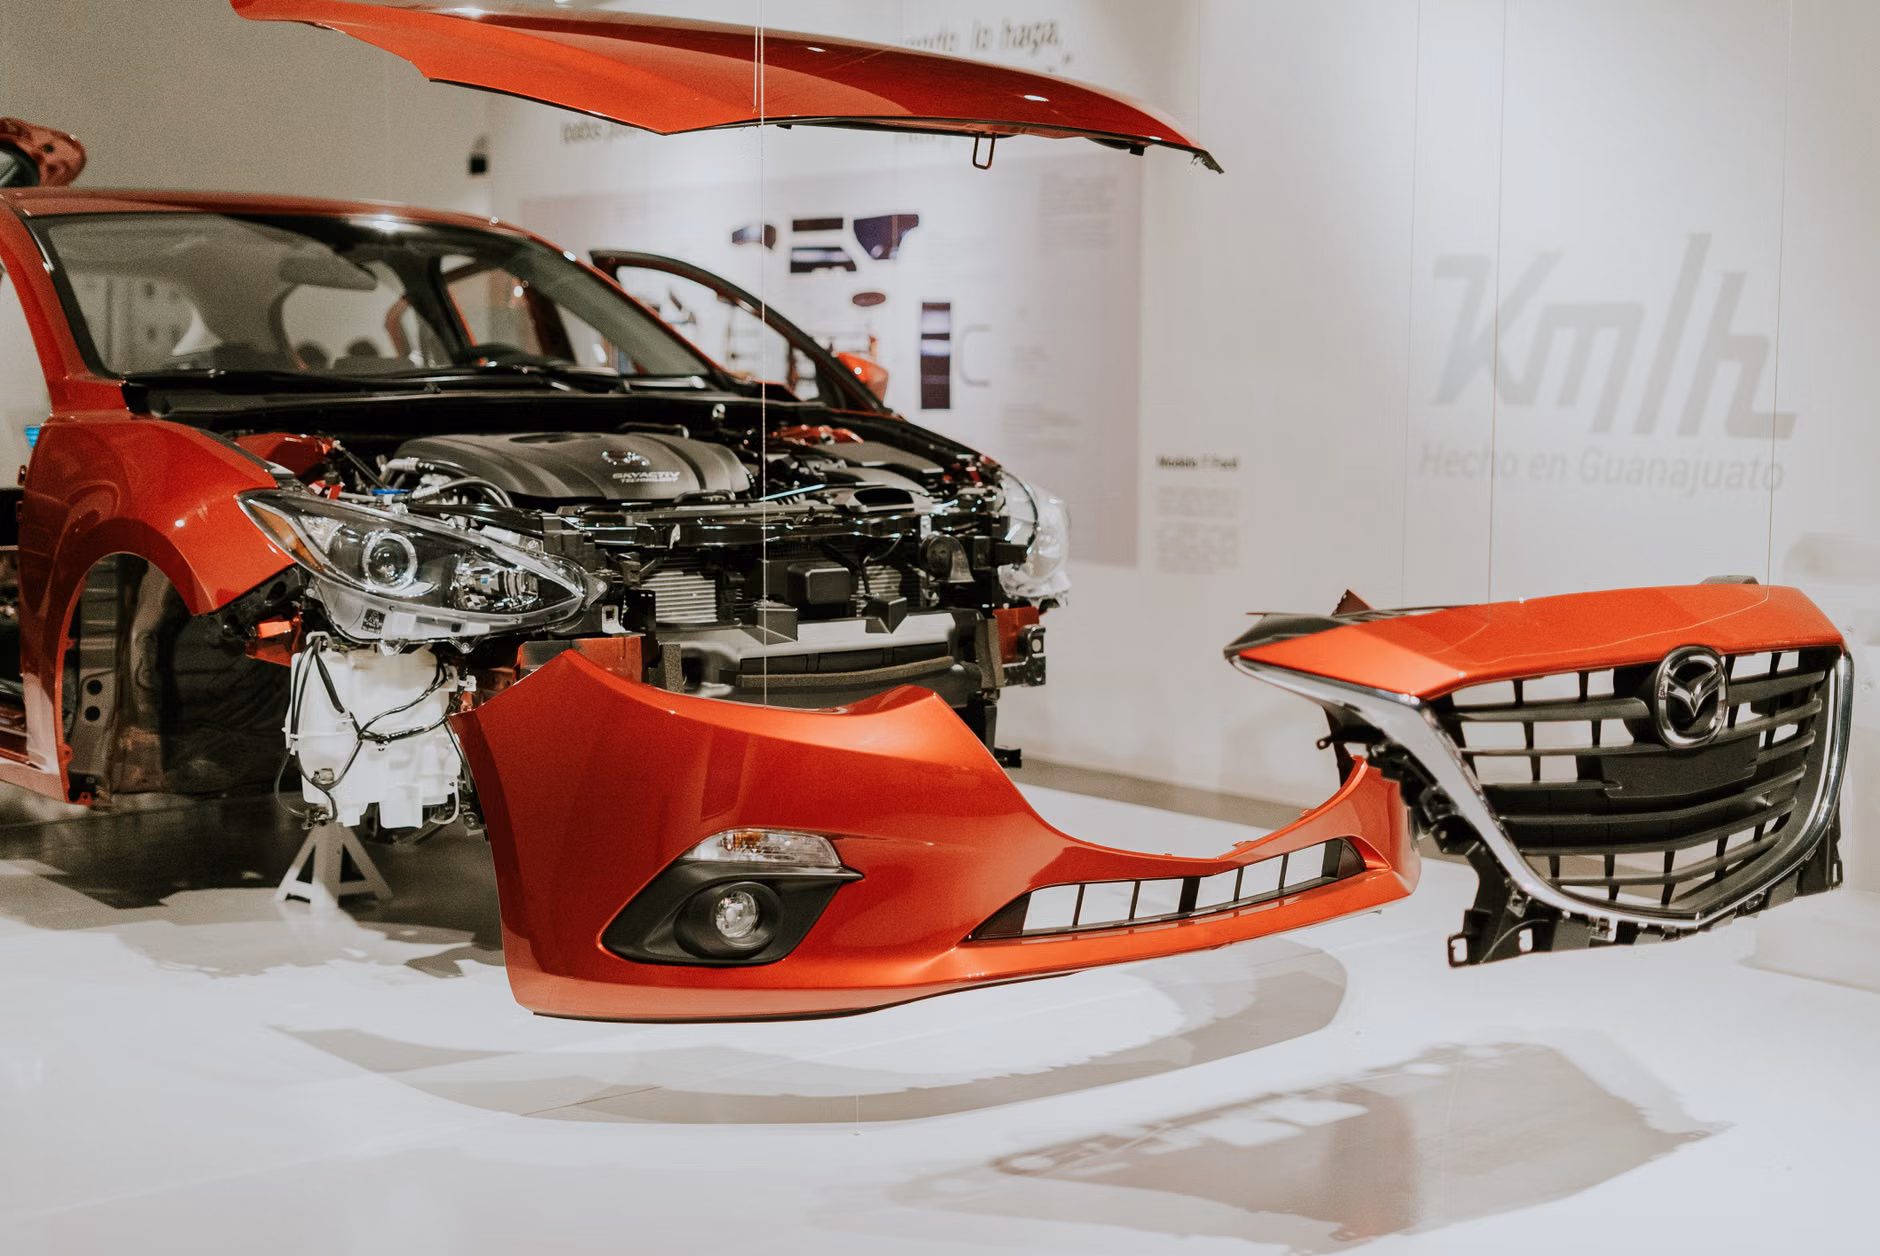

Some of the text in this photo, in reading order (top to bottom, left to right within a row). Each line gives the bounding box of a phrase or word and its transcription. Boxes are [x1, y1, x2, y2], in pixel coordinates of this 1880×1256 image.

[612, 471, 680, 479] SKYACTIV
[1417, 441, 1786, 497] Hecho en Guanajuato
